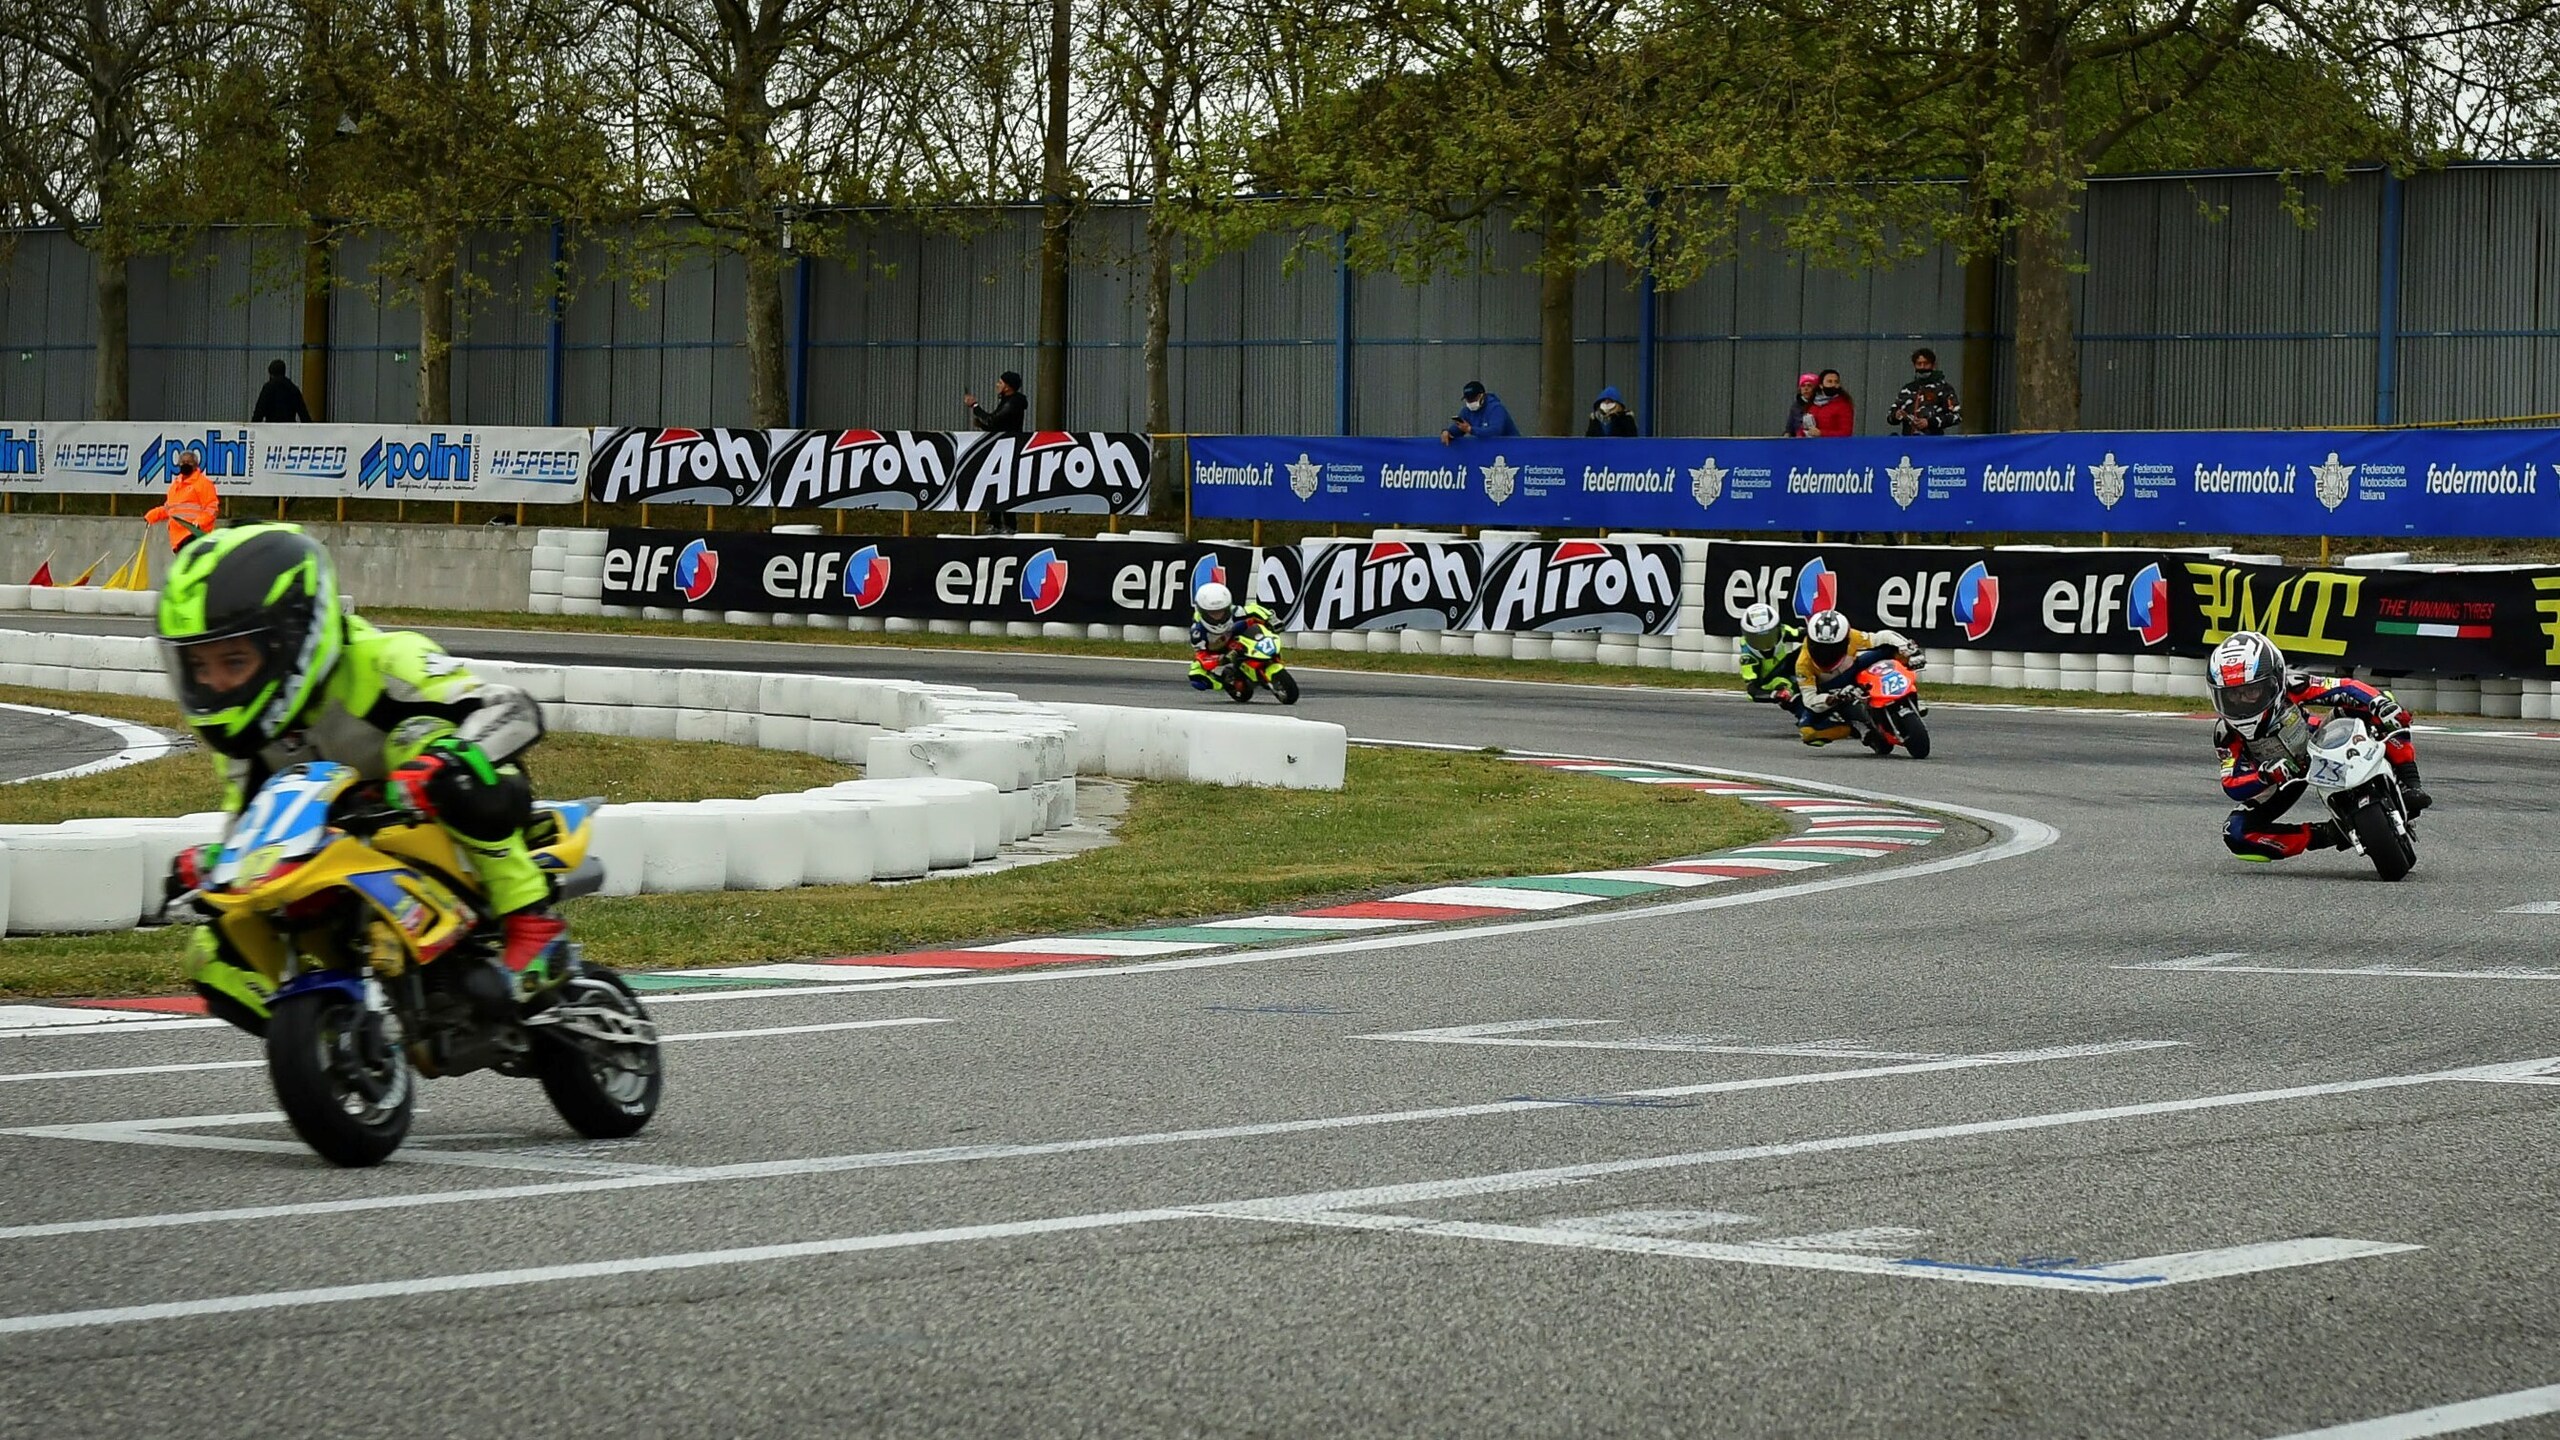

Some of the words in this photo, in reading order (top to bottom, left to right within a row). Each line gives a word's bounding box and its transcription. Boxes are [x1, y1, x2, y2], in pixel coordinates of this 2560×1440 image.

[0, 428, 37, 473] lini
[386, 433, 472, 488] polini
[472, 445, 480, 482] motori
[1195, 460, 1274, 486] federmoto.it
[1327, 463, 1363, 472] Federazione
[1524, 465, 1564, 475] Federazione
[1733, 466, 1771, 477] Federazione
[1928, 465, 1966, 476] Federazione
[2133, 463, 2174, 474] Federazione
[2361, 463, 2405, 475] Federazione
[1326, 474, 1365, 483] Motociclistica
[1380, 463, 1467, 490] federmoto.it
[1524, 475, 1566, 486] Motociclistica
[1583, 465, 1675, 493] federmoto.it
[1731, 478, 1772, 488] Motociclistica
[1787, 467, 1874, 494] federmoto.it
[1928, 477, 1967, 487] Motociclistica
[1982, 463, 2076, 493] federmoto.it
[2133, 475, 2176, 486] Motociclistica
[2194, 463, 2296, 494] federmoto.it
[2360, 476, 2407, 488] Motociclistica
[2425, 462, 2537, 494] federmoto.it
[1326, 485, 1348, 493] Italiana
[1524, 487, 1547, 497] Italiana
[1730, 489, 1753, 499] Italiana
[1927, 489, 1949, 499] Italiana
[2134, 488, 2158, 498] Italiana
[2360, 489, 2385, 500] Italiana
[603, 546, 674, 592] elf
[763, 552, 840, 599] elf
[935, 556, 1017, 605] elf
[1112, 560, 1186, 610] elf
[1724, 566, 1792, 619] elf
[1877, 571, 1951, 629] elf
[2043, 574, 2125, 633] elf
[2379, 598, 2406, 616] THE
[2408, 600, 2460, 619] WINNING
[2463, 602, 2495, 619] TYRES
[2313, 759, 2345, 783] 23
